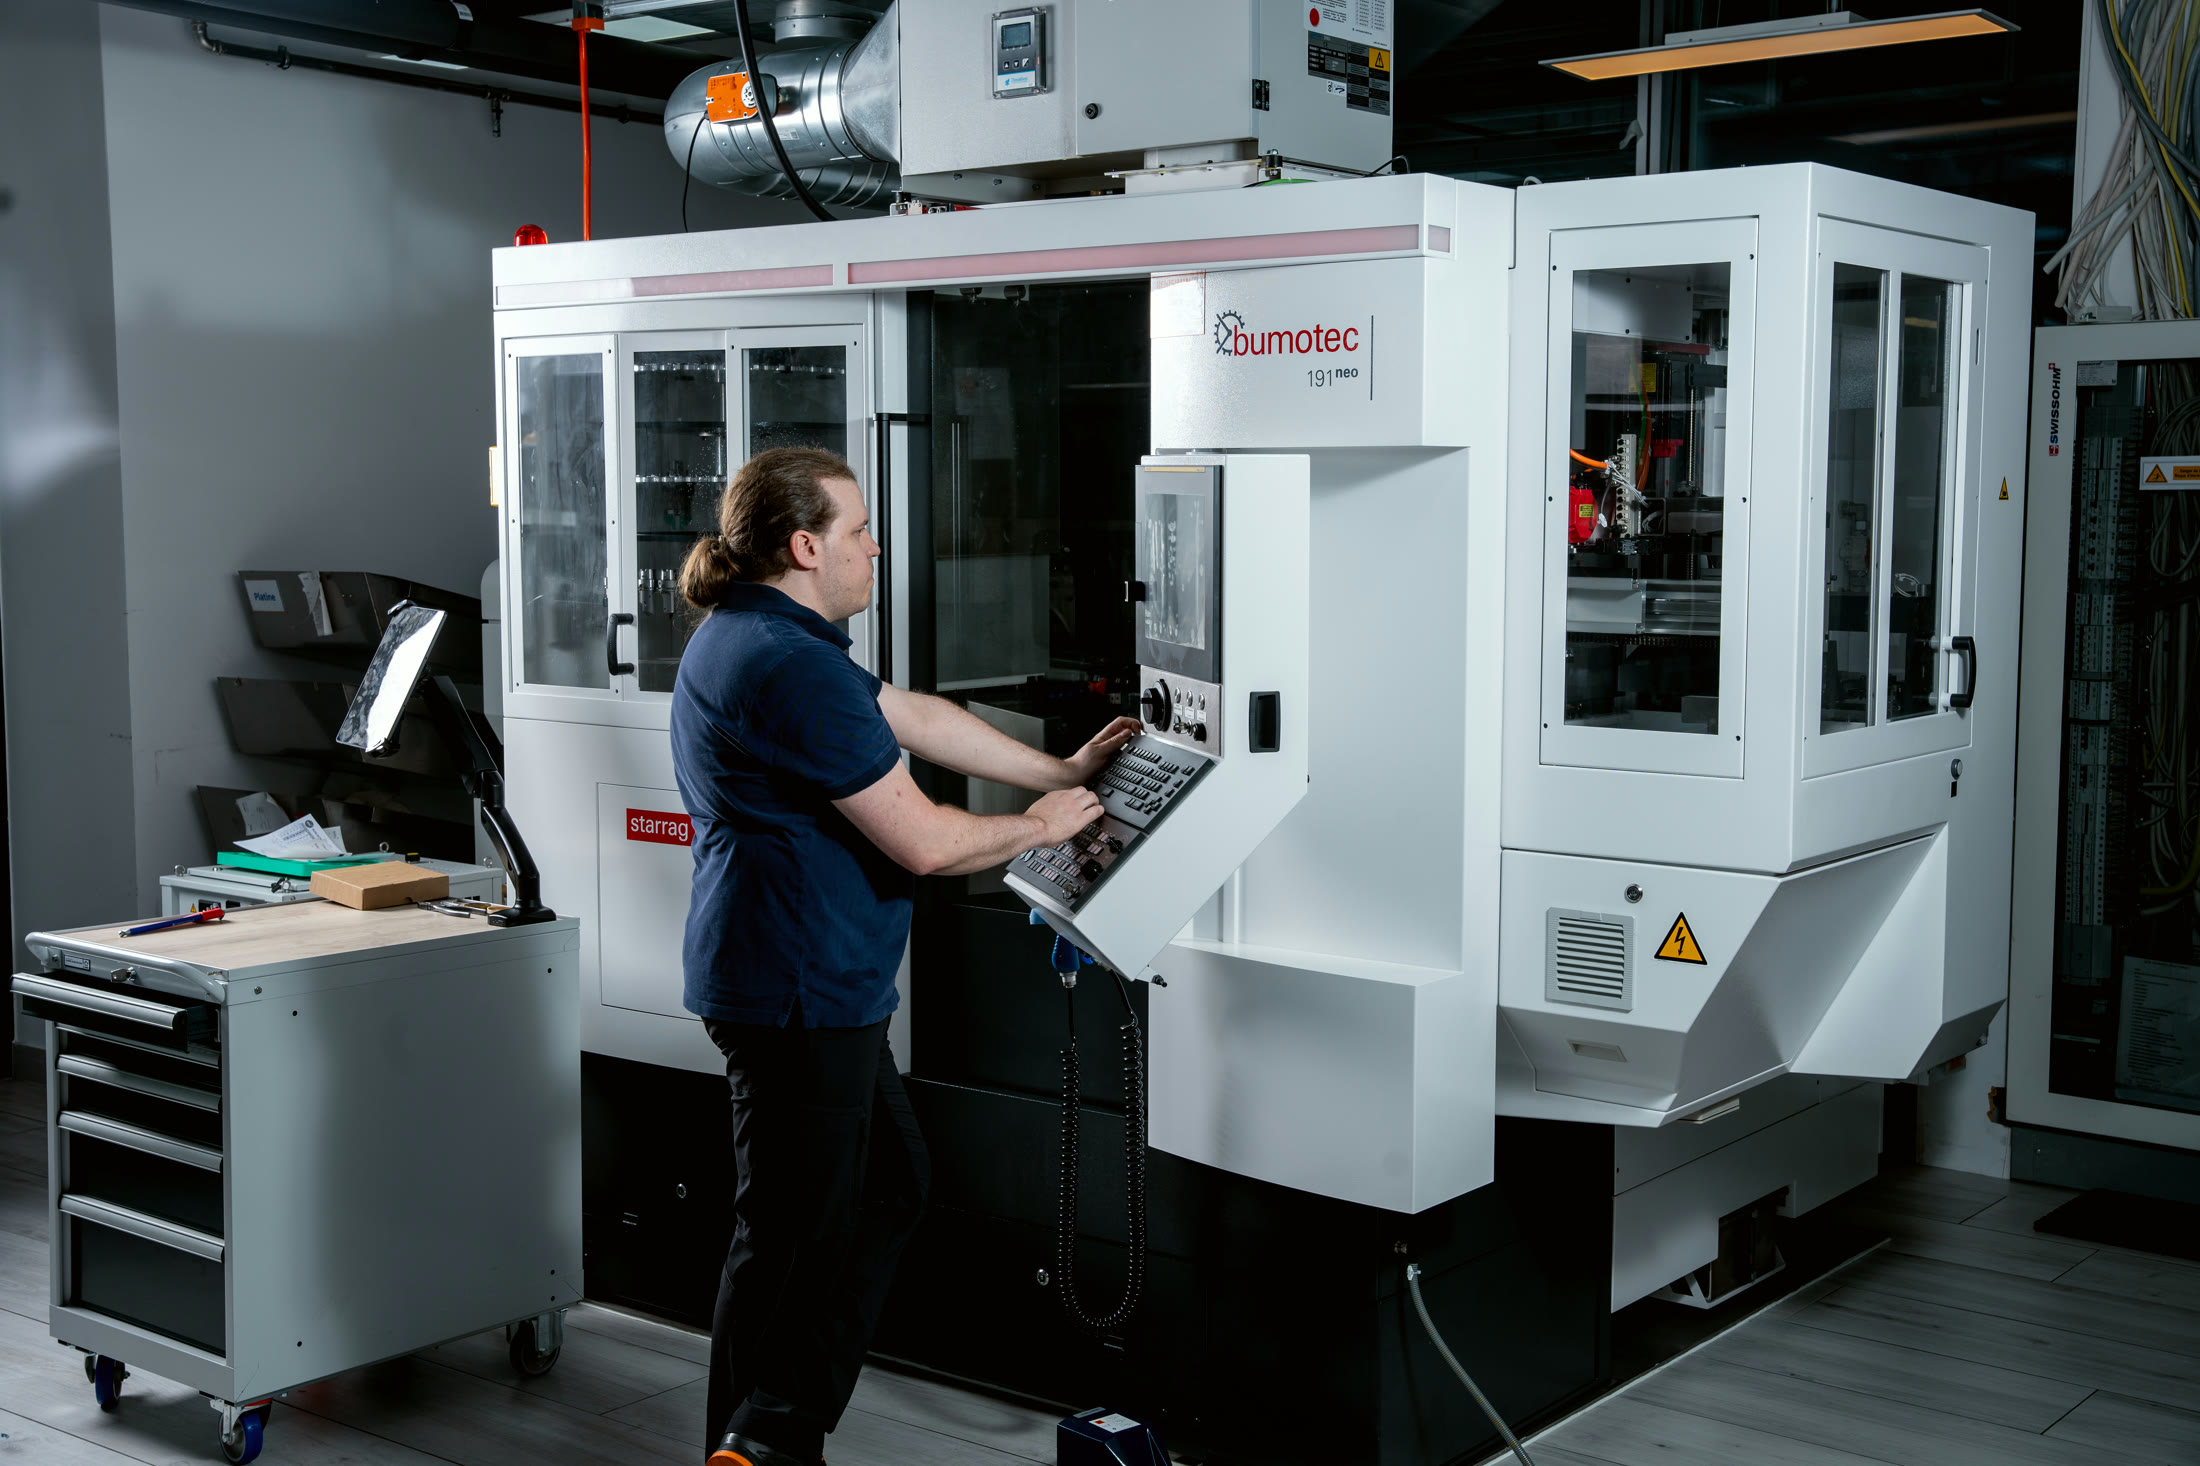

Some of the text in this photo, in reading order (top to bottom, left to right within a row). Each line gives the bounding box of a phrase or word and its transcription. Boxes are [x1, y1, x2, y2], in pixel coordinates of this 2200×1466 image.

[1234, 324, 1359, 356] bumotec
[1307, 367, 1359, 387] 191 neo
[2050, 367, 2061, 445] SWISSOHM
[253, 592, 276, 601] Platine
[630, 815, 688, 842] starrag
